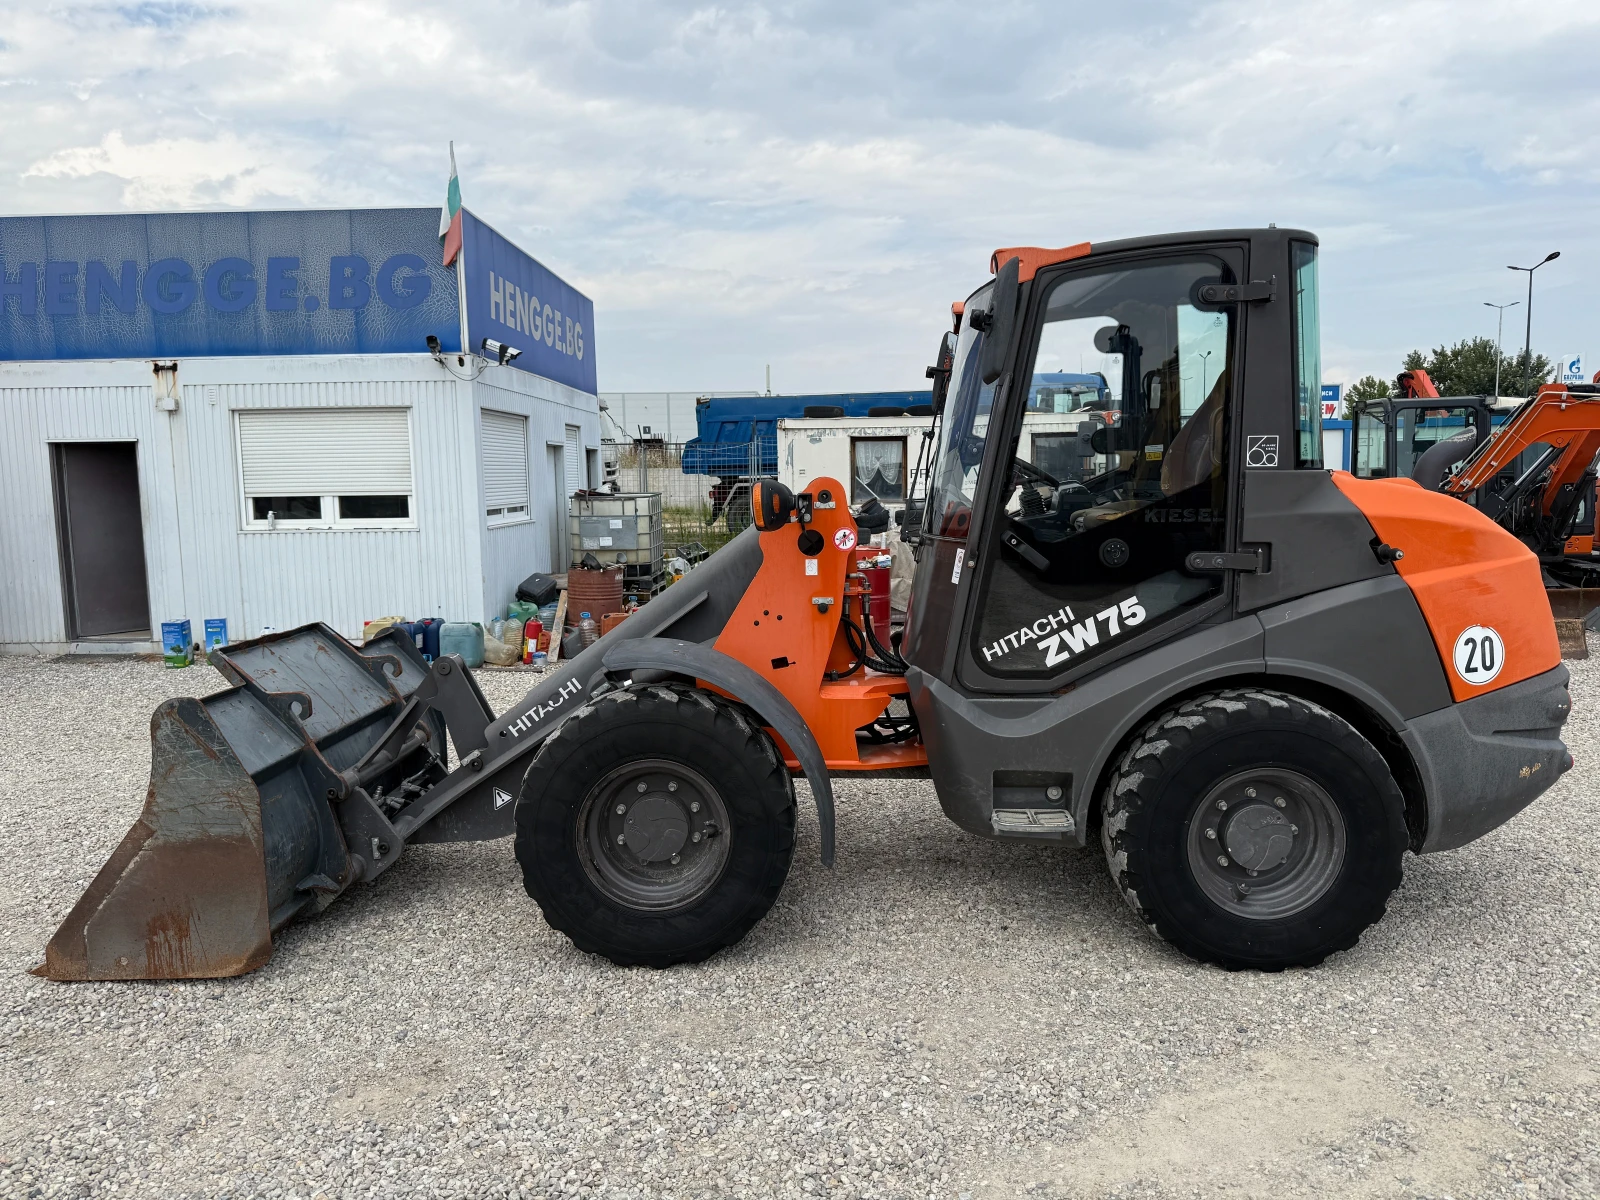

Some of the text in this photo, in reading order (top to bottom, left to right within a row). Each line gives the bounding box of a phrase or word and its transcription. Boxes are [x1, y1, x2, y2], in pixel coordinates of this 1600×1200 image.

[0, 253, 432, 316] HENGGE.BG
[489, 271, 584, 361] HENGGE.BG
[1144, 508, 1225, 523] KIESEL
[981, 605, 1076, 662] HITACHI
[1463, 635, 1495, 674] 20
